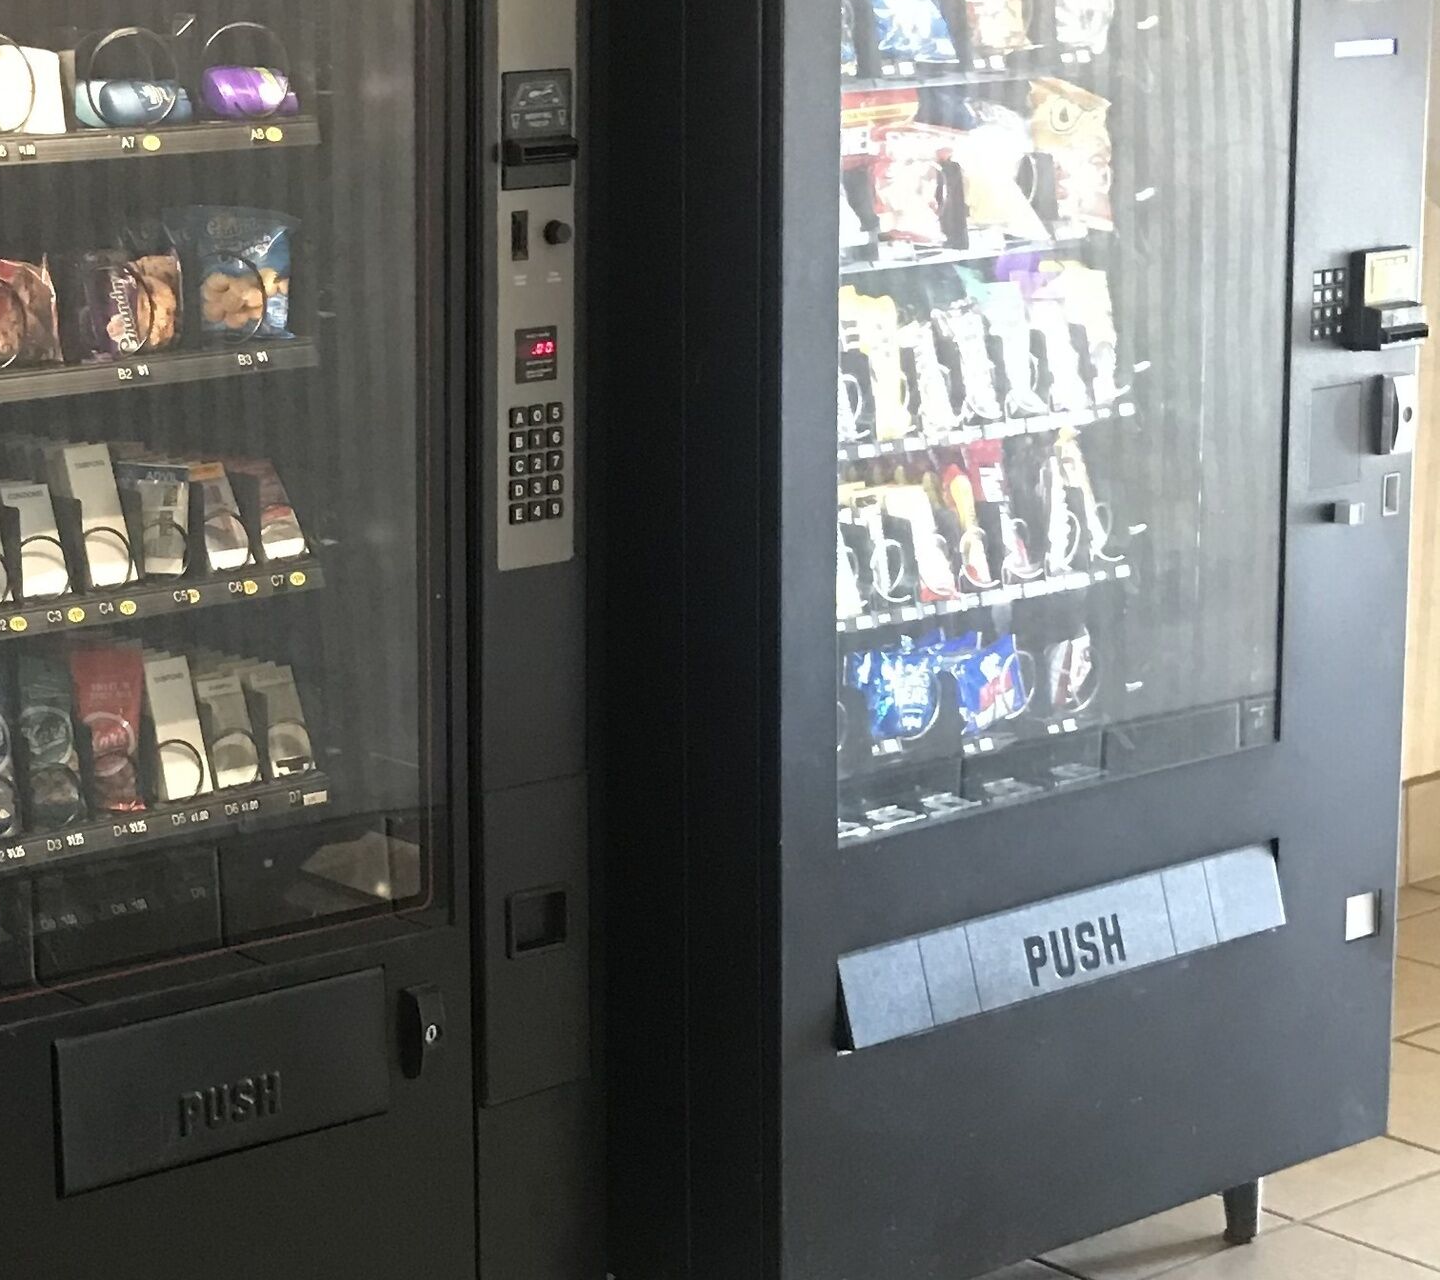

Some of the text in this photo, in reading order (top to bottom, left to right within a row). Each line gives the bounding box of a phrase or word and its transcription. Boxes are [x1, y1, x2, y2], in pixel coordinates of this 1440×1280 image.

[251, 128, 264, 141] A8
[121, 136, 135, 149] A7
[238, 351, 269, 367] B3 $1
[118, 364, 150, 381] B2 $1
[515, 412, 523, 425] A
[533, 409, 541, 422] 0
[552, 407, 559, 419] 5
[515, 436, 522, 449] B
[534, 433, 540, 445] 1
[552, 431, 560, 444] 6
[515, 460, 523, 472] C
[533, 457, 541, 470] 2
[552, 455, 560, 467] 7
[515, 484, 523, 496] D
[533, 481, 541, 494] 3
[552, 479, 559, 491] 8
[515, 508, 523, 520] E
[533, 505, 541, 517] 4
[552, 502, 559, 515] 9
[229, 580, 243, 594] C6
[271, 574, 284, 587] C7
[173, 590, 187, 603] C5
[99, 601, 114, 614] C4
[47, 610, 62, 623] C3
[289, 790, 301, 803] D7
[224, 803, 239, 816] D6
[172, 812, 186, 825] D5
[114, 823, 128, 837] D4
[47, 838, 62, 851] D3
[1023, 912, 1127, 987] PUSH
[177, 1070, 283, 1138] PUSH
